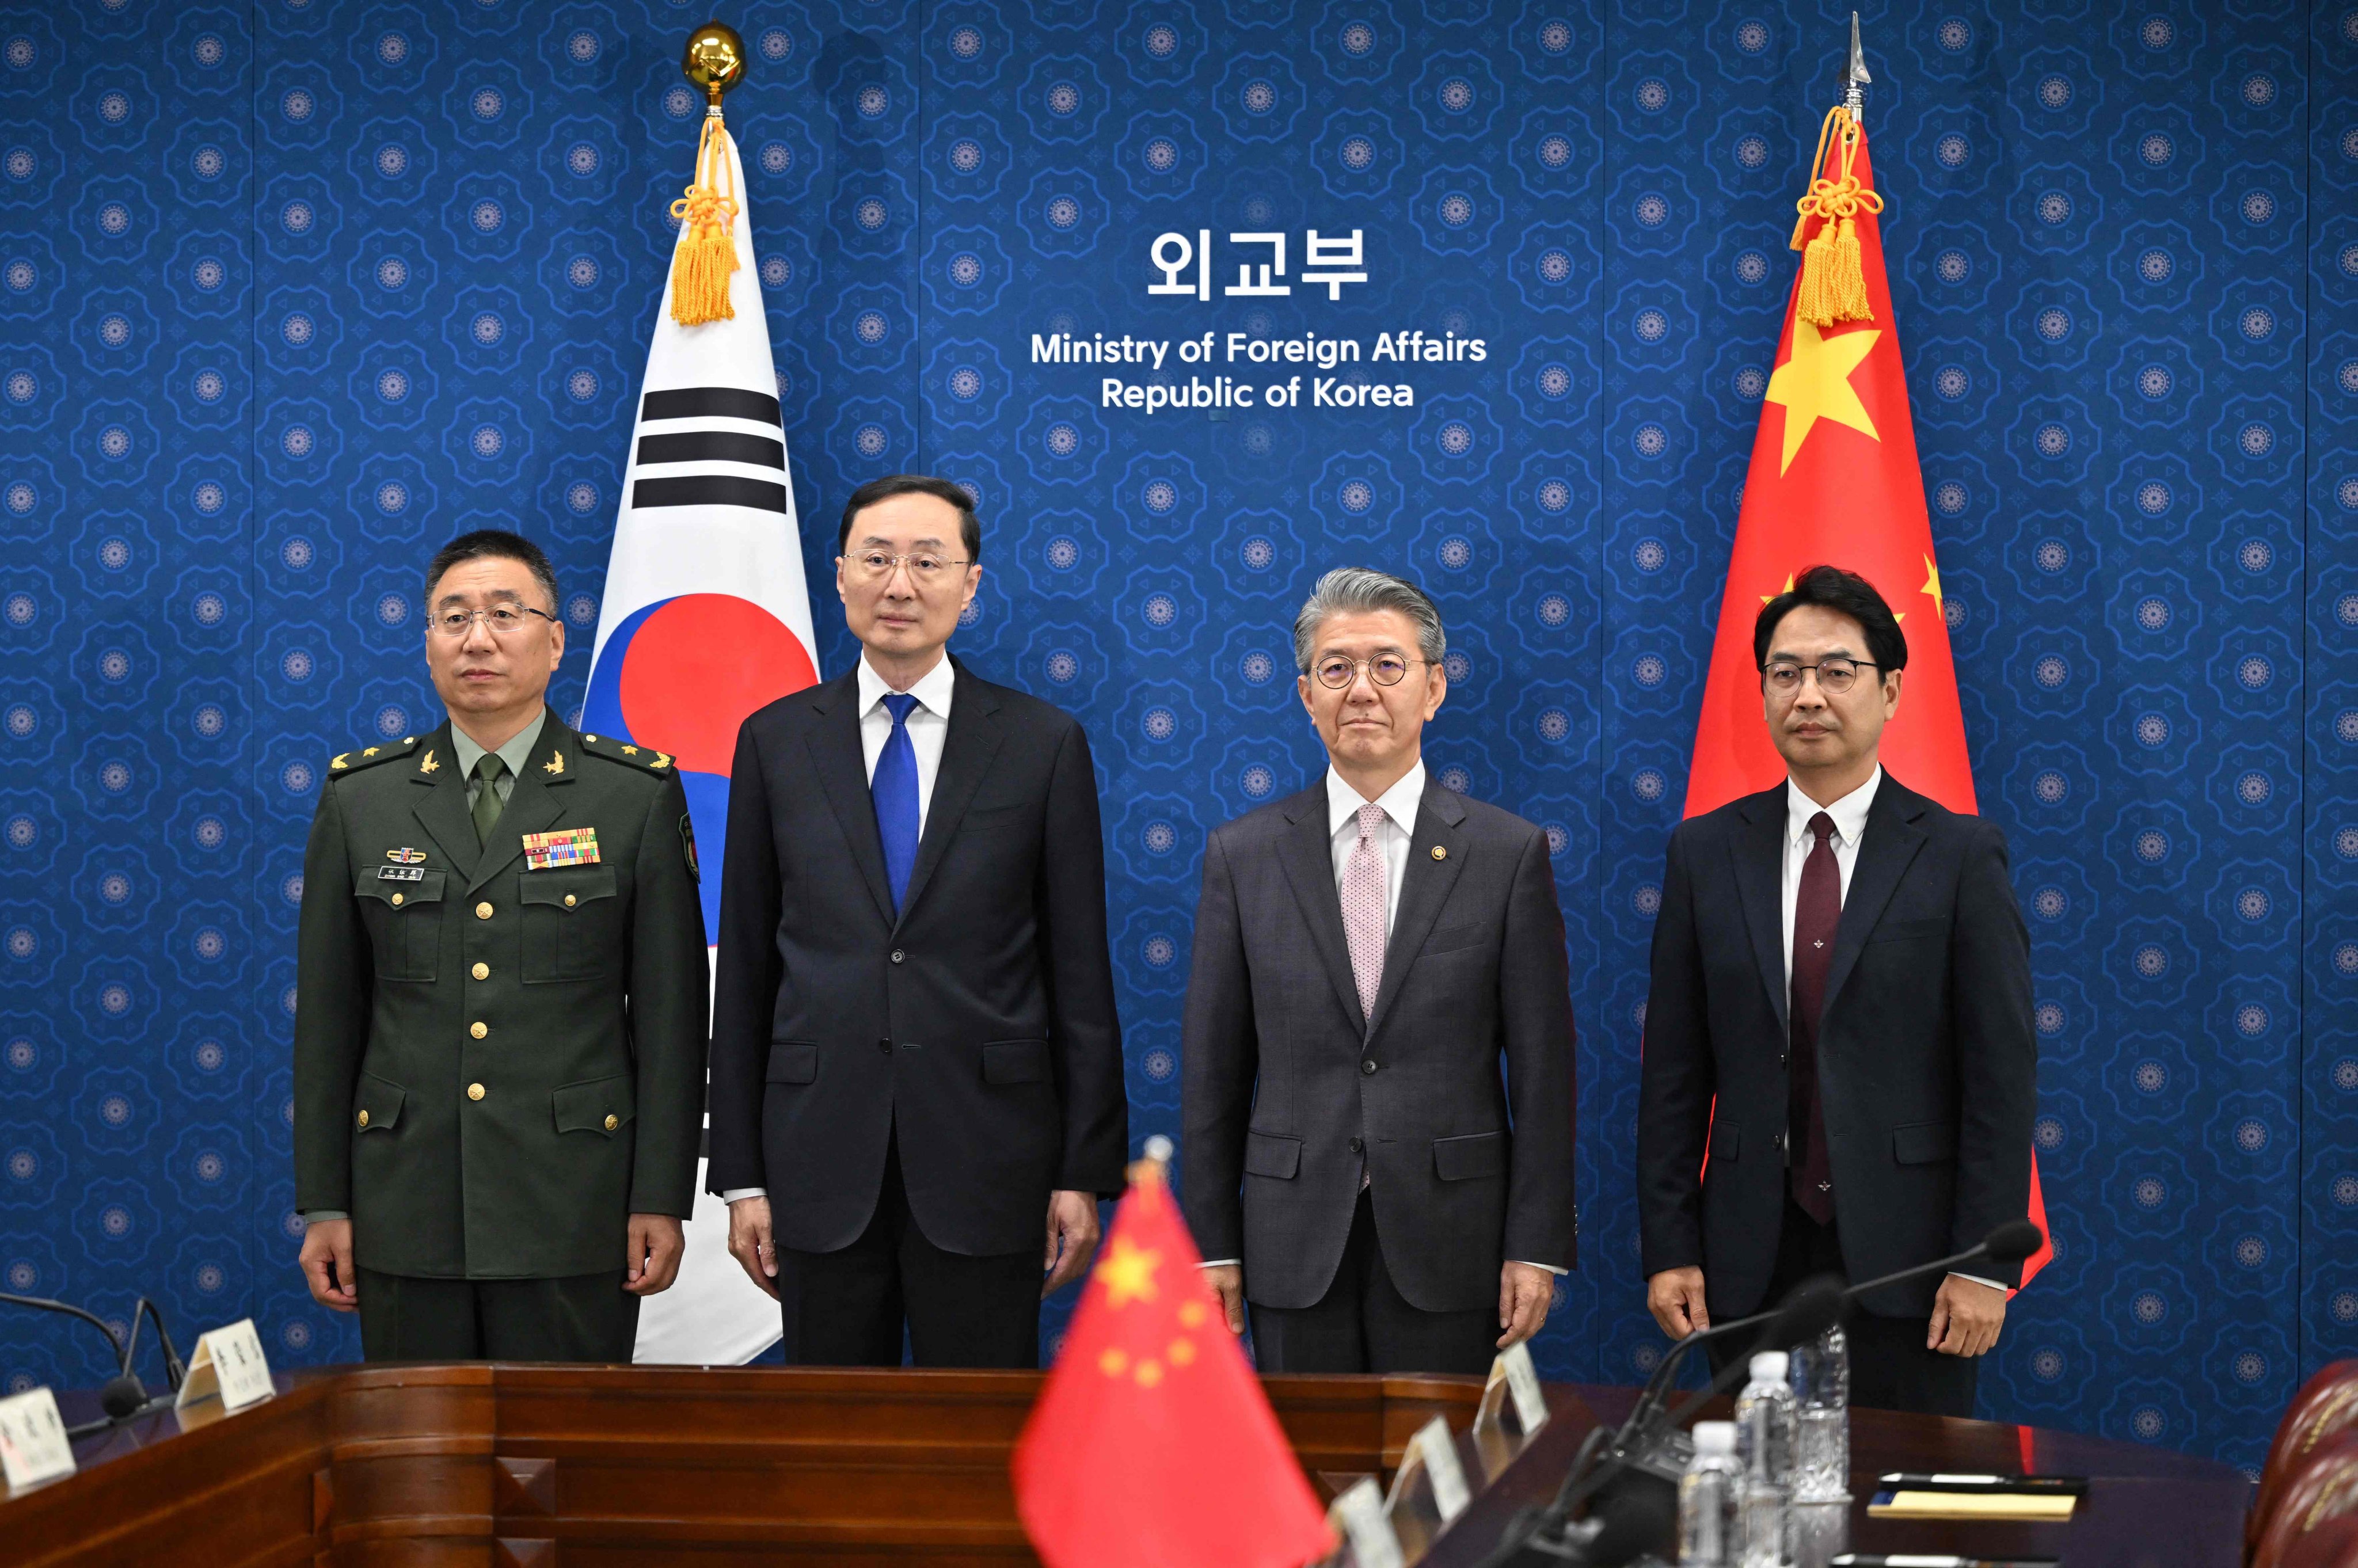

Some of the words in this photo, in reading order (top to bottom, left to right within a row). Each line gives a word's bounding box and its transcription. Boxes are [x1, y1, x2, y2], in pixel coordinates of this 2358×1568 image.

[1147, 229, 1368, 301] 외교부
[1031, 333, 1169, 370] Ministry
[1179, 332, 1215, 363] of
[1227, 333, 1360, 370] Foreign
[1371, 330, 1487, 361] Affairs
[1102, 376, 1253, 414] Republic
[1265, 376, 1300, 407] of
[1314, 377, 1413, 407] Korea
